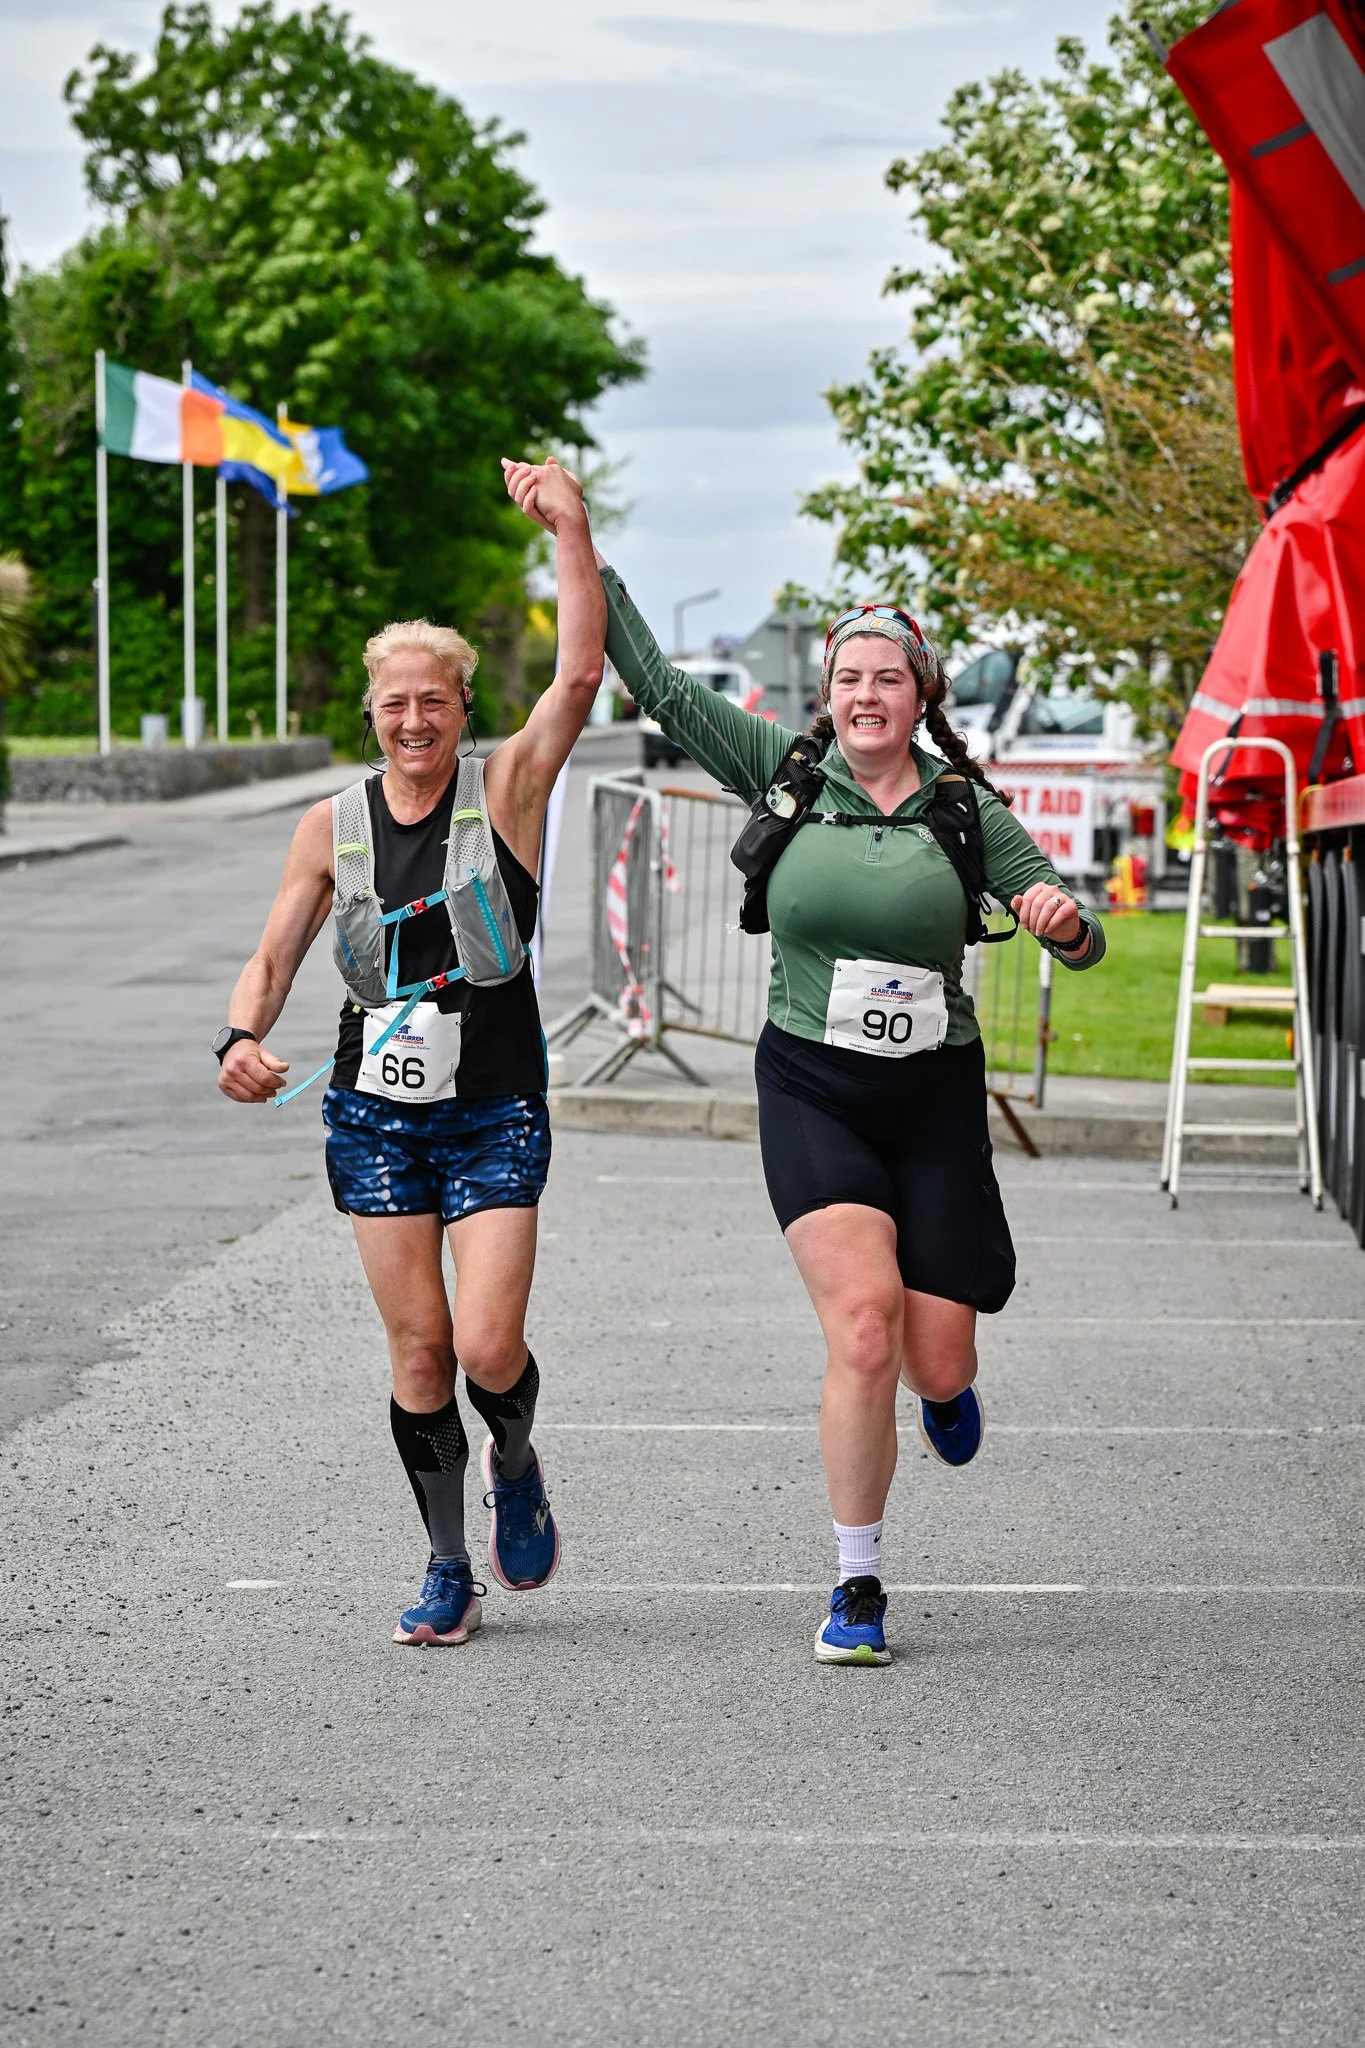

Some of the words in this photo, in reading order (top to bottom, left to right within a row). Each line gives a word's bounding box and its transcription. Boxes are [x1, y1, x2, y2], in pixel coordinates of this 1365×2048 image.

[1039, 787, 1082, 816] AID
[890, 989, 914, 997] BURREN
[401, 1034, 424, 1042] BURREN
[862, 1009, 913, 1044] 90
[382, 1053, 425, 1089] 66
